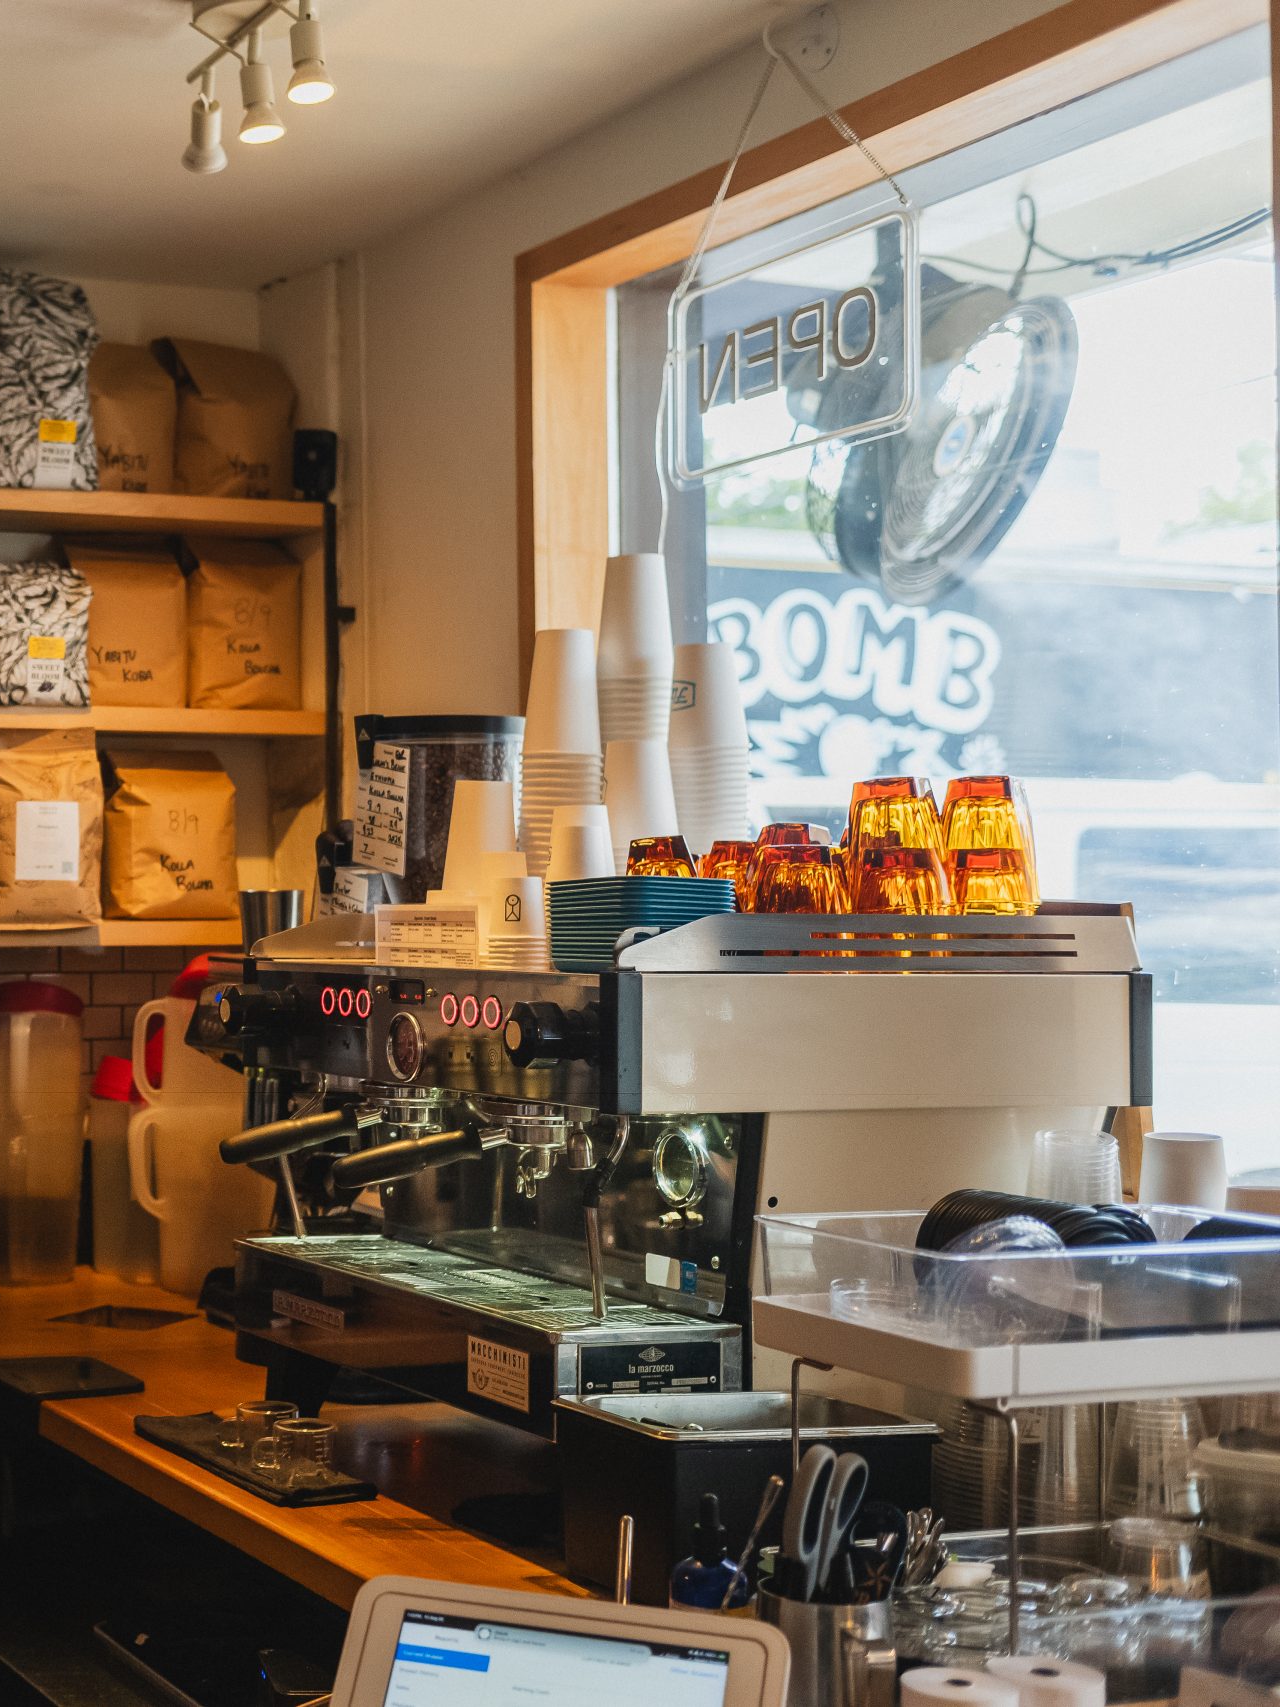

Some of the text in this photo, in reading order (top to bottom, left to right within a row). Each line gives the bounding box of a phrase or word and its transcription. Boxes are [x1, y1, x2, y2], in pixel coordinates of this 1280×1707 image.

[707, 588, 1001, 734] BOMB
[471, 1340, 526, 1370] MACCHINISTI
[628, 1363, 674, 1374] la marzocco
